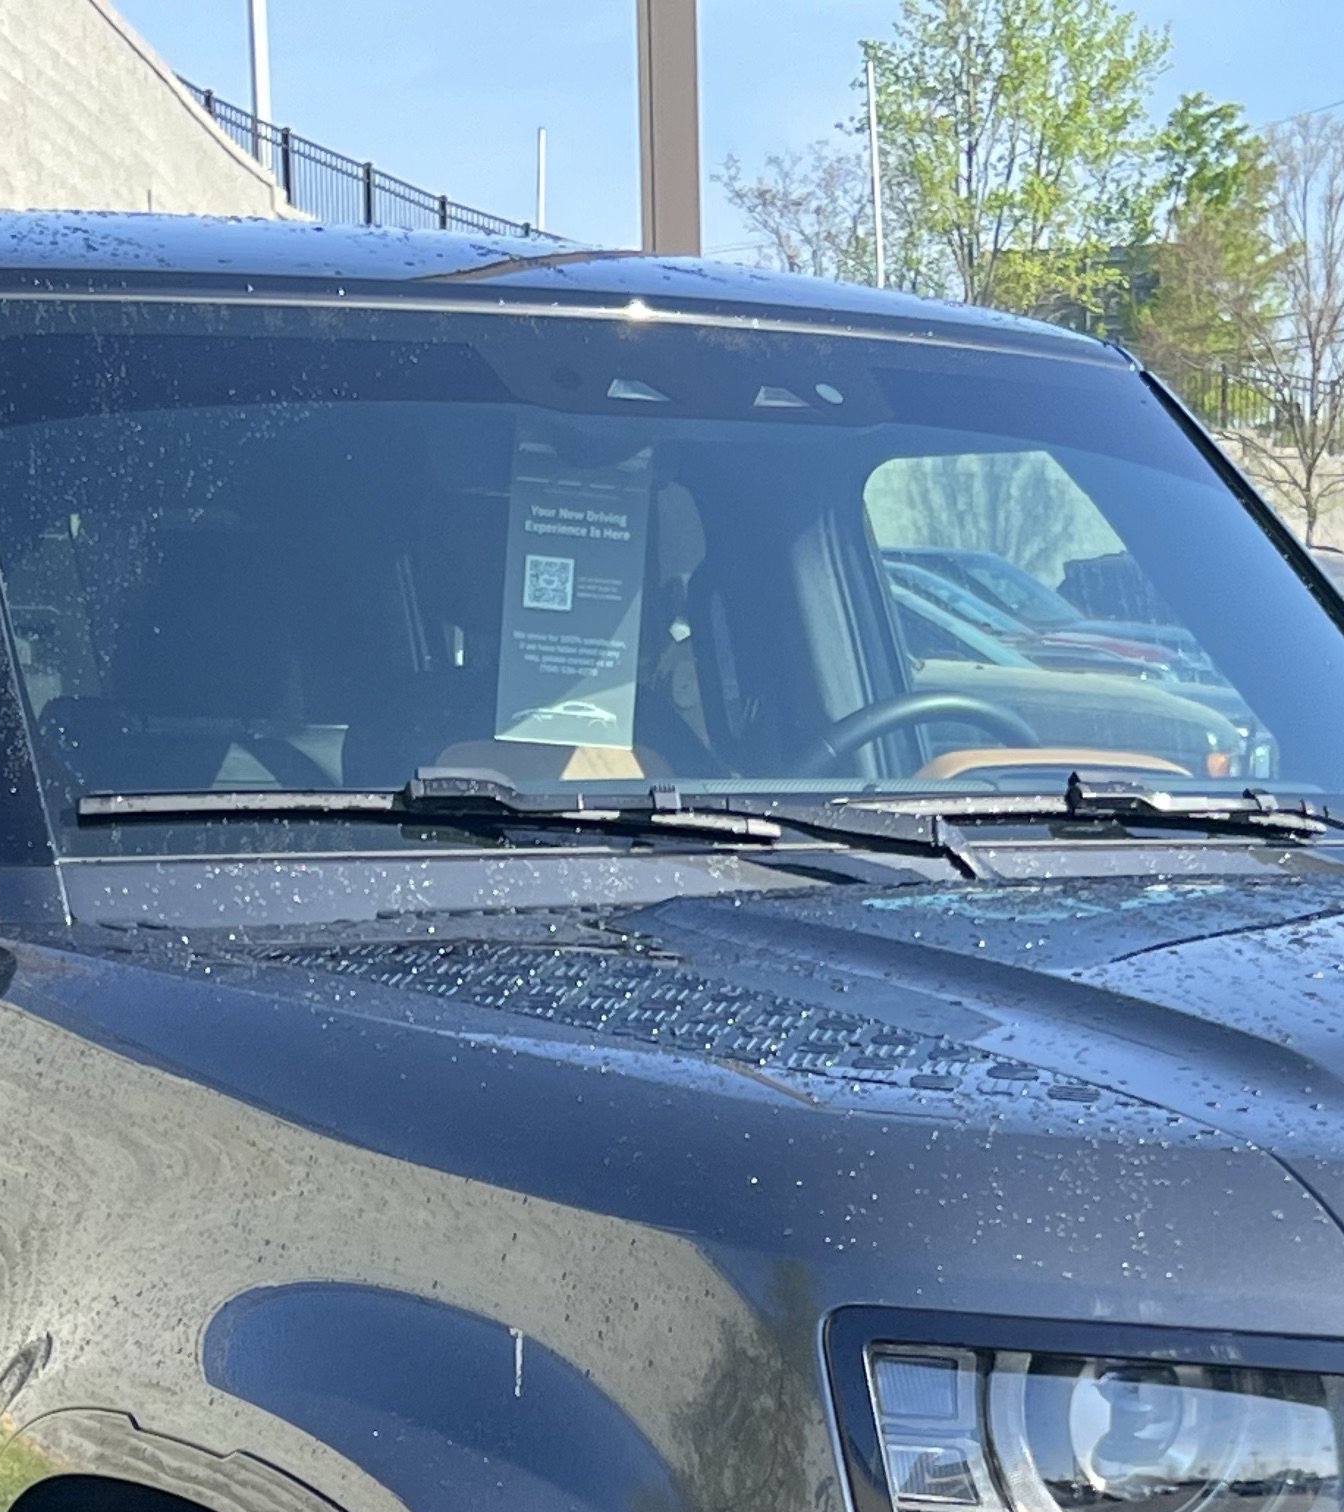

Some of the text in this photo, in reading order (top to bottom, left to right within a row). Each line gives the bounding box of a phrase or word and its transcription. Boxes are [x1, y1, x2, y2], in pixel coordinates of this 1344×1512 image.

[530, 504, 627, 527] Your New Driving
[524, 519, 587, 535] Experience
[603, 528, 630, 541] Here
